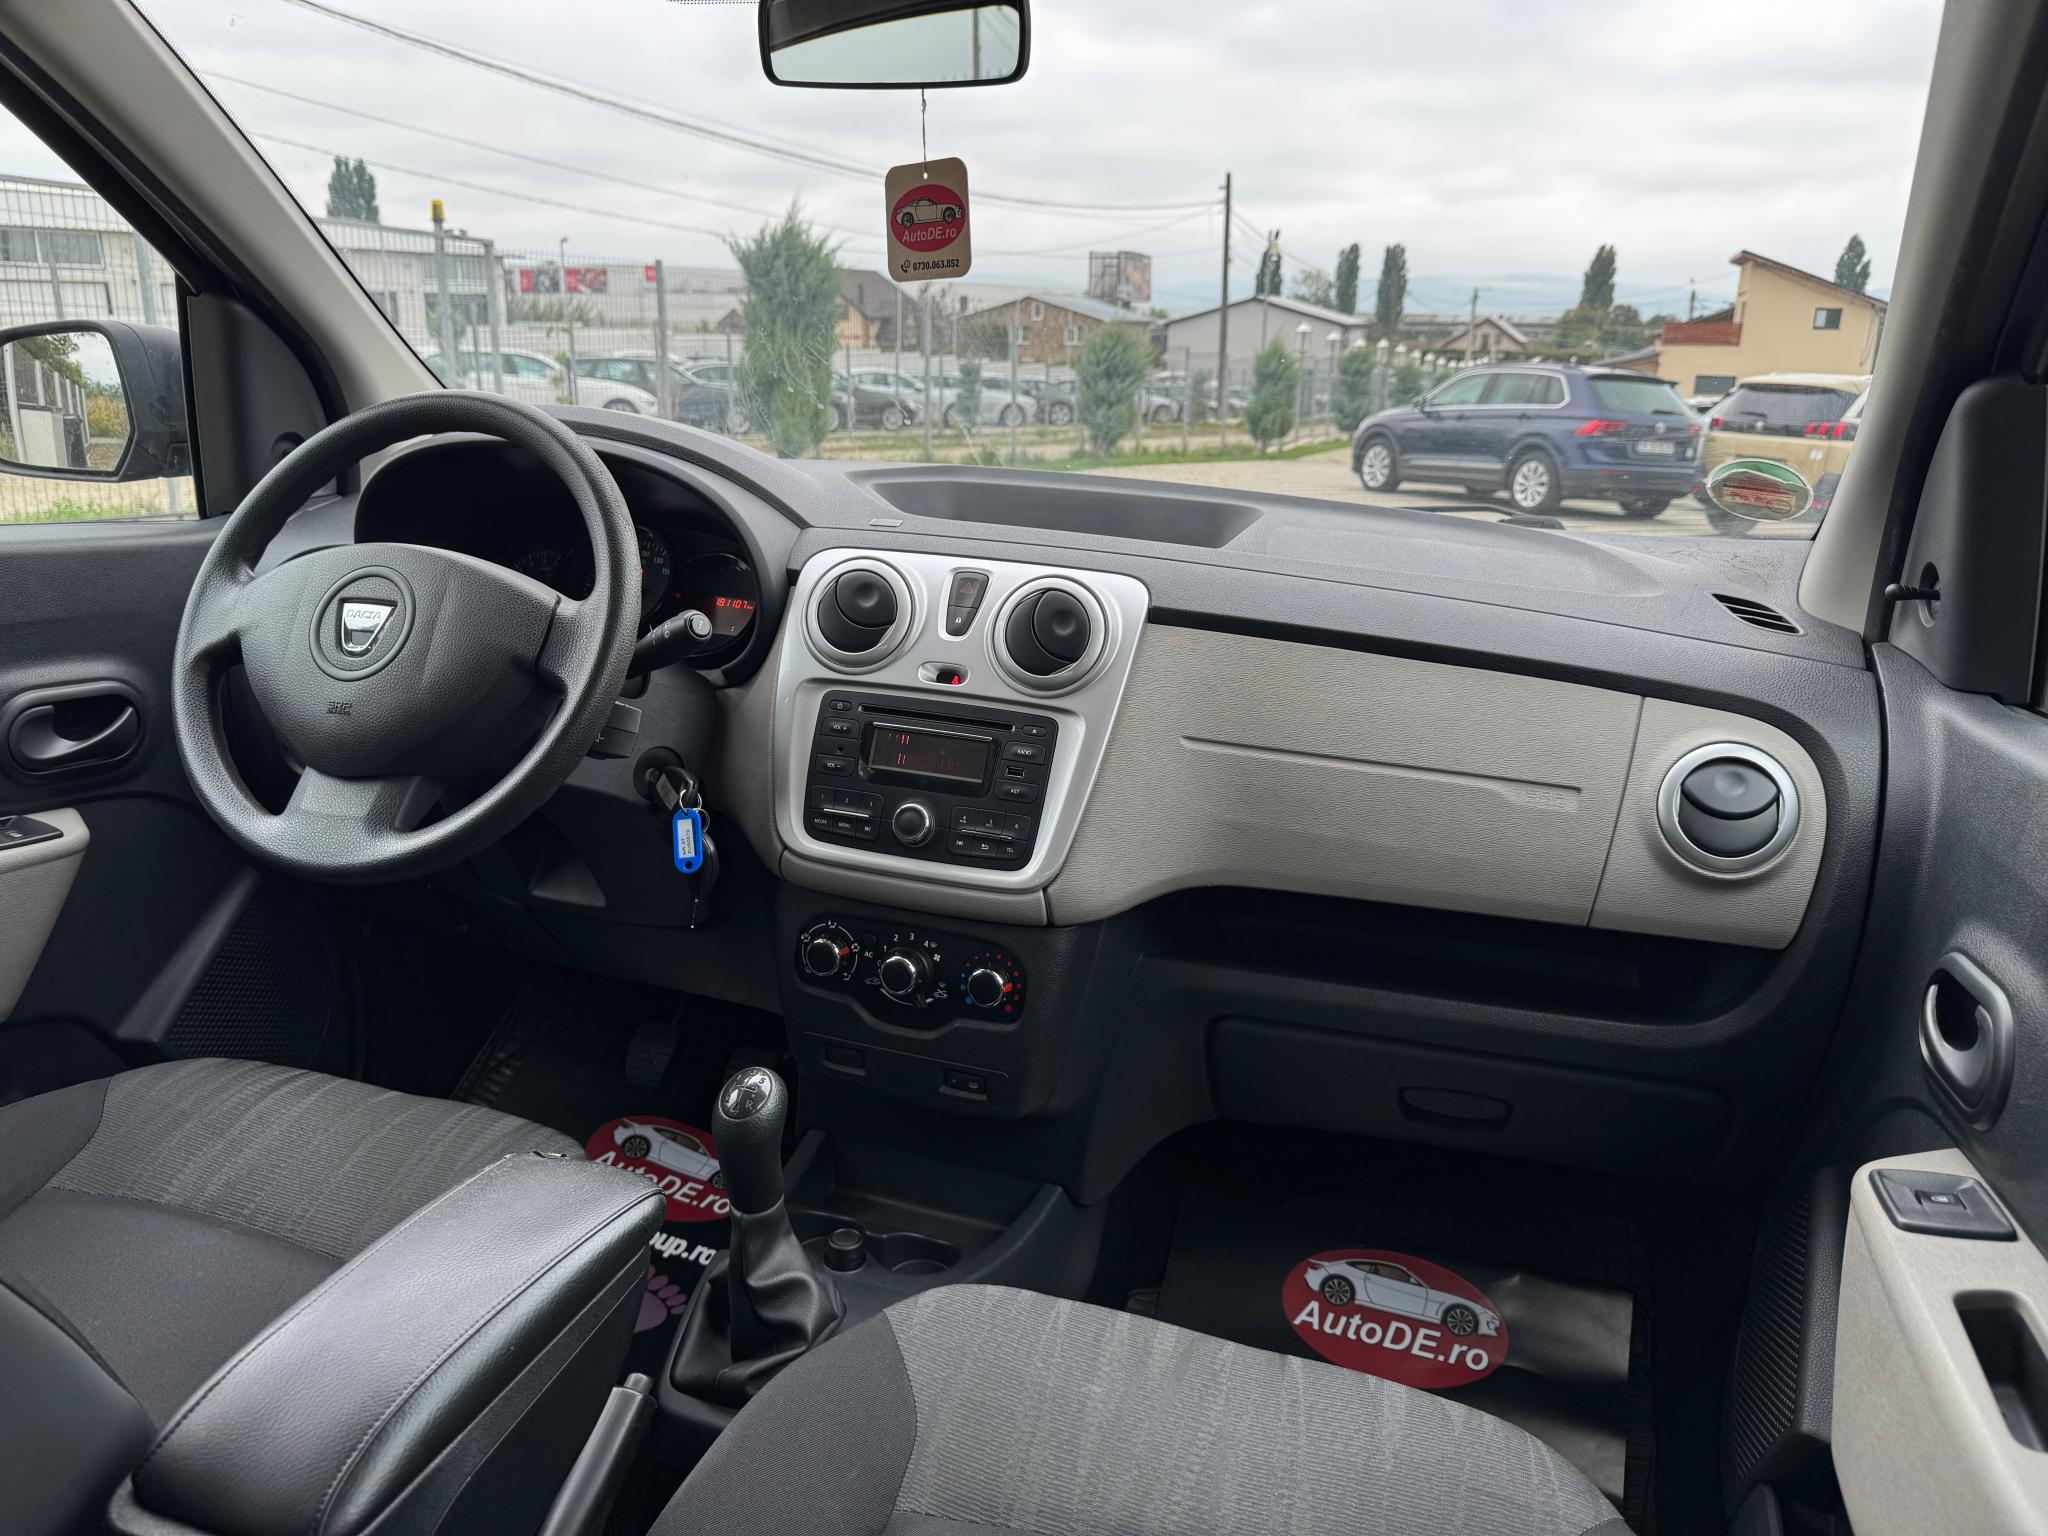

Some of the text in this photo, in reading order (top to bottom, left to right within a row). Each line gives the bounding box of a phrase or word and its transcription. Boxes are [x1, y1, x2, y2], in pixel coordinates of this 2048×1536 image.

[902, 226, 957, 243] AutoDE.ro
[912, 259, 960, 271] 0730.063.852
[346, 609, 382, 620] DACIA
[909, 932, 915, 940] 3
[923, 940, 929, 948] 4
[1293, 1300, 1490, 1371] AutoDE.ro
